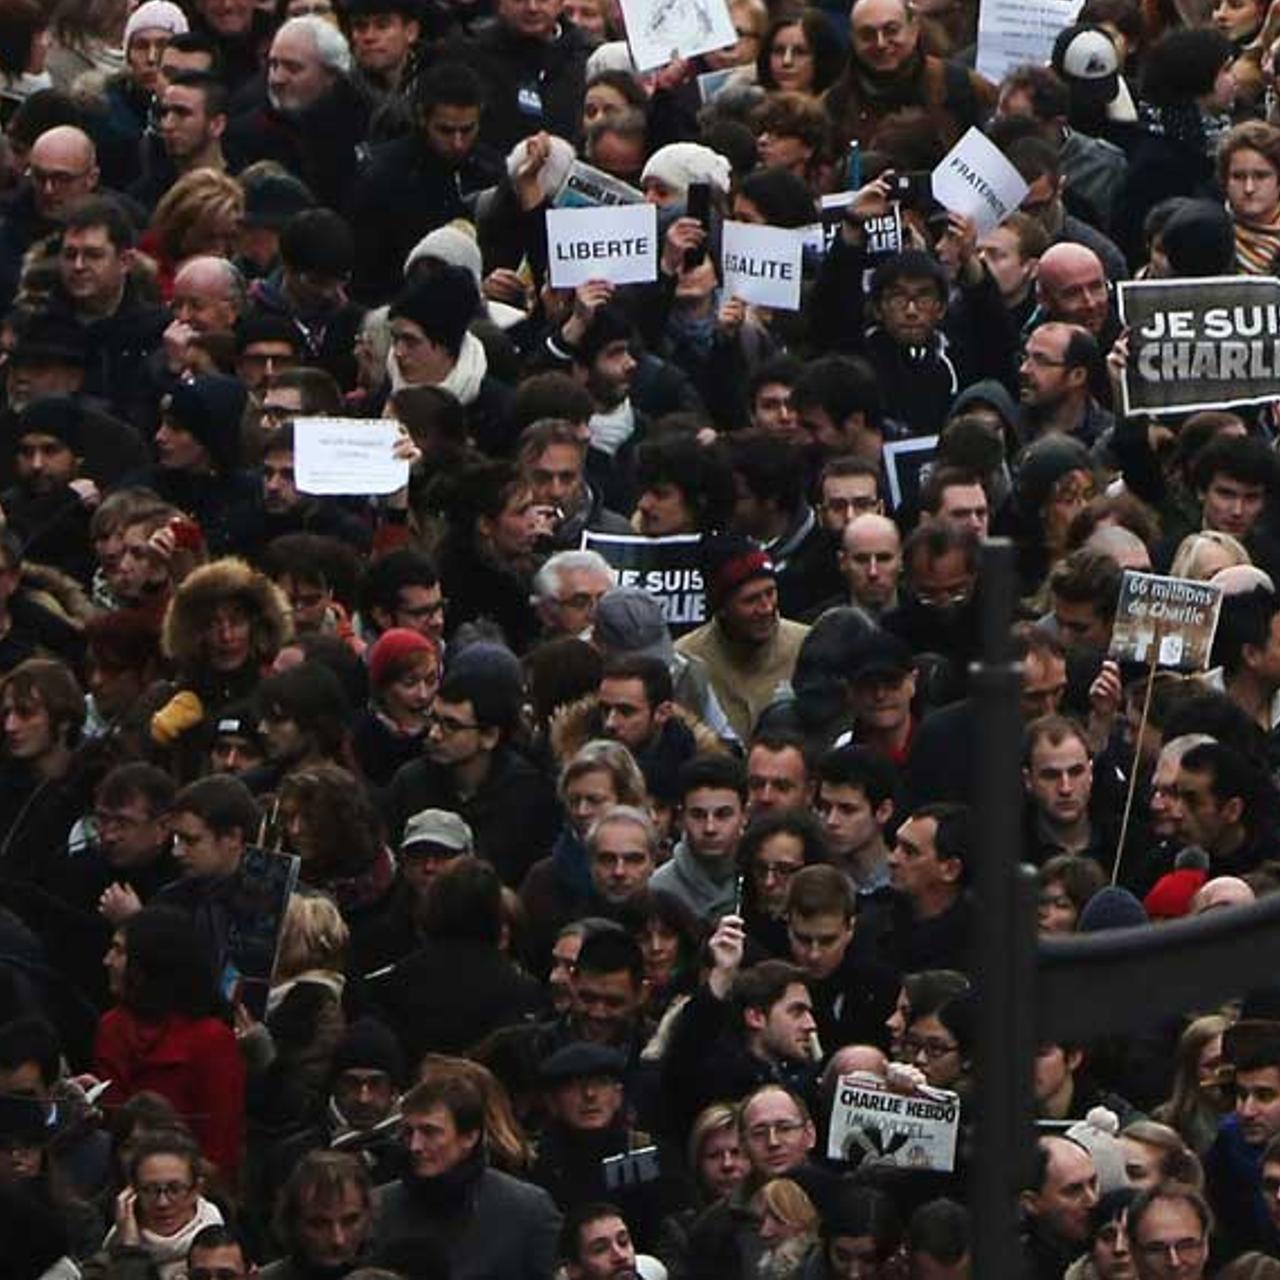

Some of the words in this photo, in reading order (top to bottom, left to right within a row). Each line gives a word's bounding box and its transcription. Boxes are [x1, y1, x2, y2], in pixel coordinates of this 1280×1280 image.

[556, 237, 649, 261] LIBERTE
[1141, 311, 1195, 340] JE
[645, 569, 705, 592] SUIS
[1129, 578, 1148, 595] 66
[1151, 581, 1213, 605] millions
[1128, 598, 1148, 614] de
[1151, 599, 1205, 625] Charlie
[840, 1089, 902, 1112] CHARLIE
[905, 1098, 956, 1124] HEBDO
